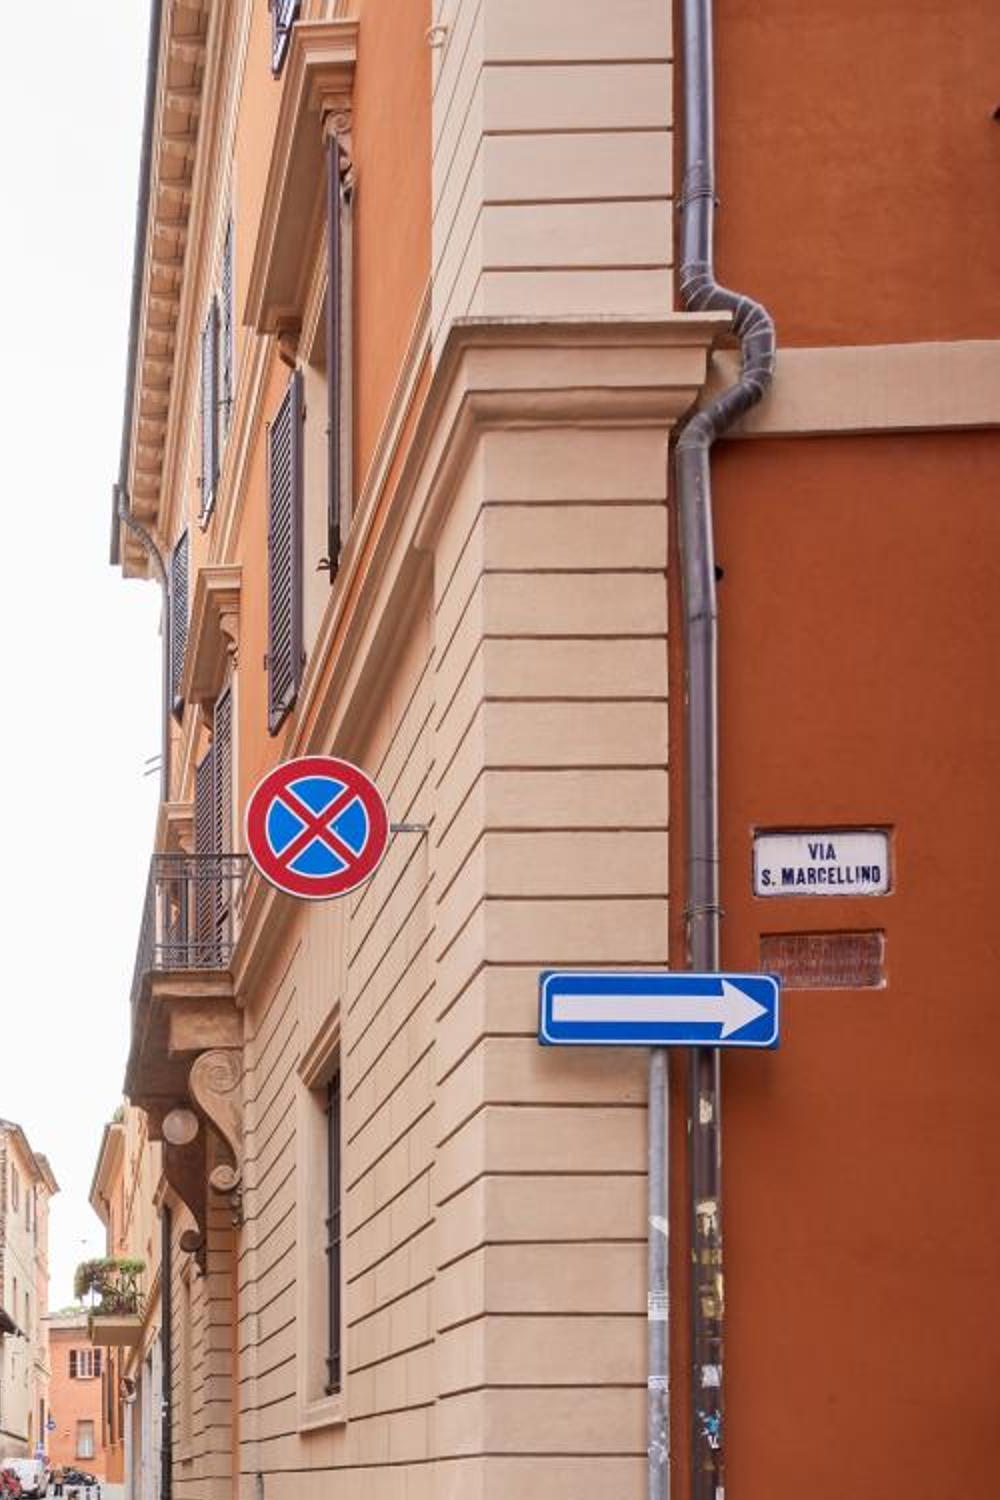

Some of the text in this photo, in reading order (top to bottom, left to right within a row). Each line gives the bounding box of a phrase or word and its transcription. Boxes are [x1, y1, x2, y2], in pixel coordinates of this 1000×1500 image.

[808, 843, 836, 860] VIA
[761, 865, 881, 886] S. MARCELLINO
